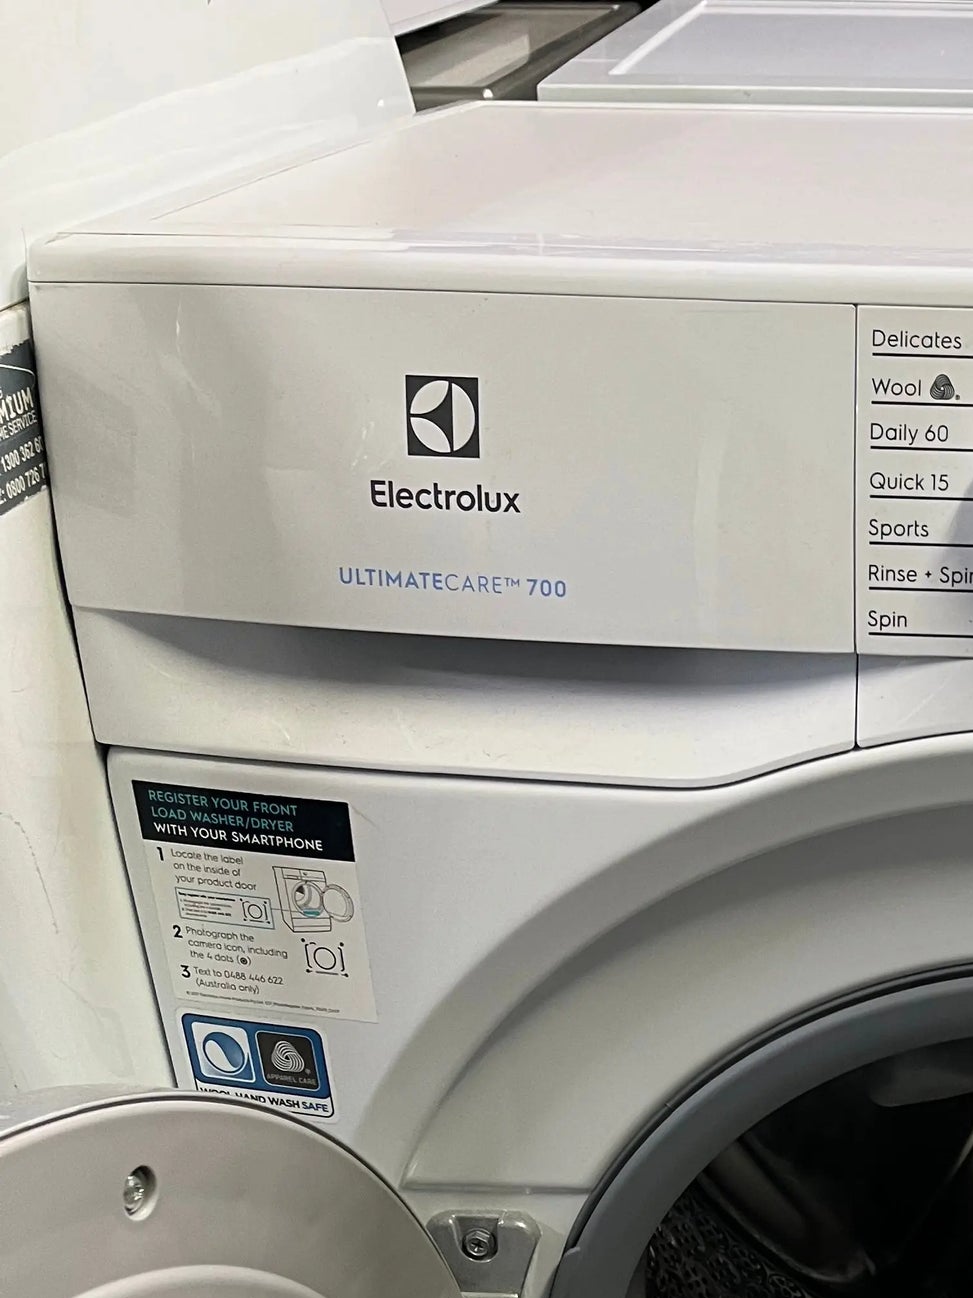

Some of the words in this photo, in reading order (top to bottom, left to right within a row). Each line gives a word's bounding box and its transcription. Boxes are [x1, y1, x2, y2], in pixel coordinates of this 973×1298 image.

[873, 330, 961, 349] Delicates
[872, 378, 921, 396] Wool
[8, 409, 38, 436] SERVICE
[871, 423, 918, 445] Daily
[925, 425, 948, 442] 60
[1, 449, 20, 472] 1300
[19, 441, 35, 462] 362
[6, 475, 26, 499] 0800
[25, 467, 40, 487] 726
[870, 472, 924, 490] Quick
[931, 474, 948, 491] 15
[371, 480, 520, 513] Electrolux
[869, 519, 928, 539] Sports
[869, 565, 917, 582] Rinse
[527, 579, 566, 597] 700
[868, 610, 907, 630] Spin
[148, 790, 208, 807] REGISTER
[211, 797, 248, 811] YOUR
[253, 802, 297, 816] FRONT
[151, 807, 186, 820] LOAD
[190, 810, 293, 832] WASHER/DRYER
[154, 822, 187, 836] WITH
[190, 826, 227, 841] YOUR
[232, 832, 323, 851] SMARTPHONE
[157, 846, 164, 861] 1
[170, 848, 201, 860] Locate
[204, 853, 219, 862] the
[221, 855, 243, 864] label
[187, 863, 201, 872] the
[204, 866, 230, 875] inside
[232, 868, 241, 876] of
[175, 874, 194, 883] your
[198, 877, 233, 888] product
[235, 879, 256, 890] door
[172, 925, 183, 938] 2
[186, 926, 238, 941] Photograph
[240, 932, 254, 942] the
[188, 939, 222, 950] camera
[224, 944, 245, 954] icon,
[248, 946, 288, 959] including
[190, 950, 205, 959] the
[206, 952, 213, 960] 4
[215, 953, 234, 963] dots
[180, 965, 191, 978] 3
[194, 967, 211, 976] Text
[213, 968, 222, 977] to
[224, 971, 246, 980] 0488
[249, 974, 265, 982] 446
[267, 974, 284, 985] 622
[196, 978, 237, 990] (Australia
[238, 985, 259, 994] only)
[268, 1096, 300, 1108] WASH
[302, 1102, 329, 1113] SAFE
